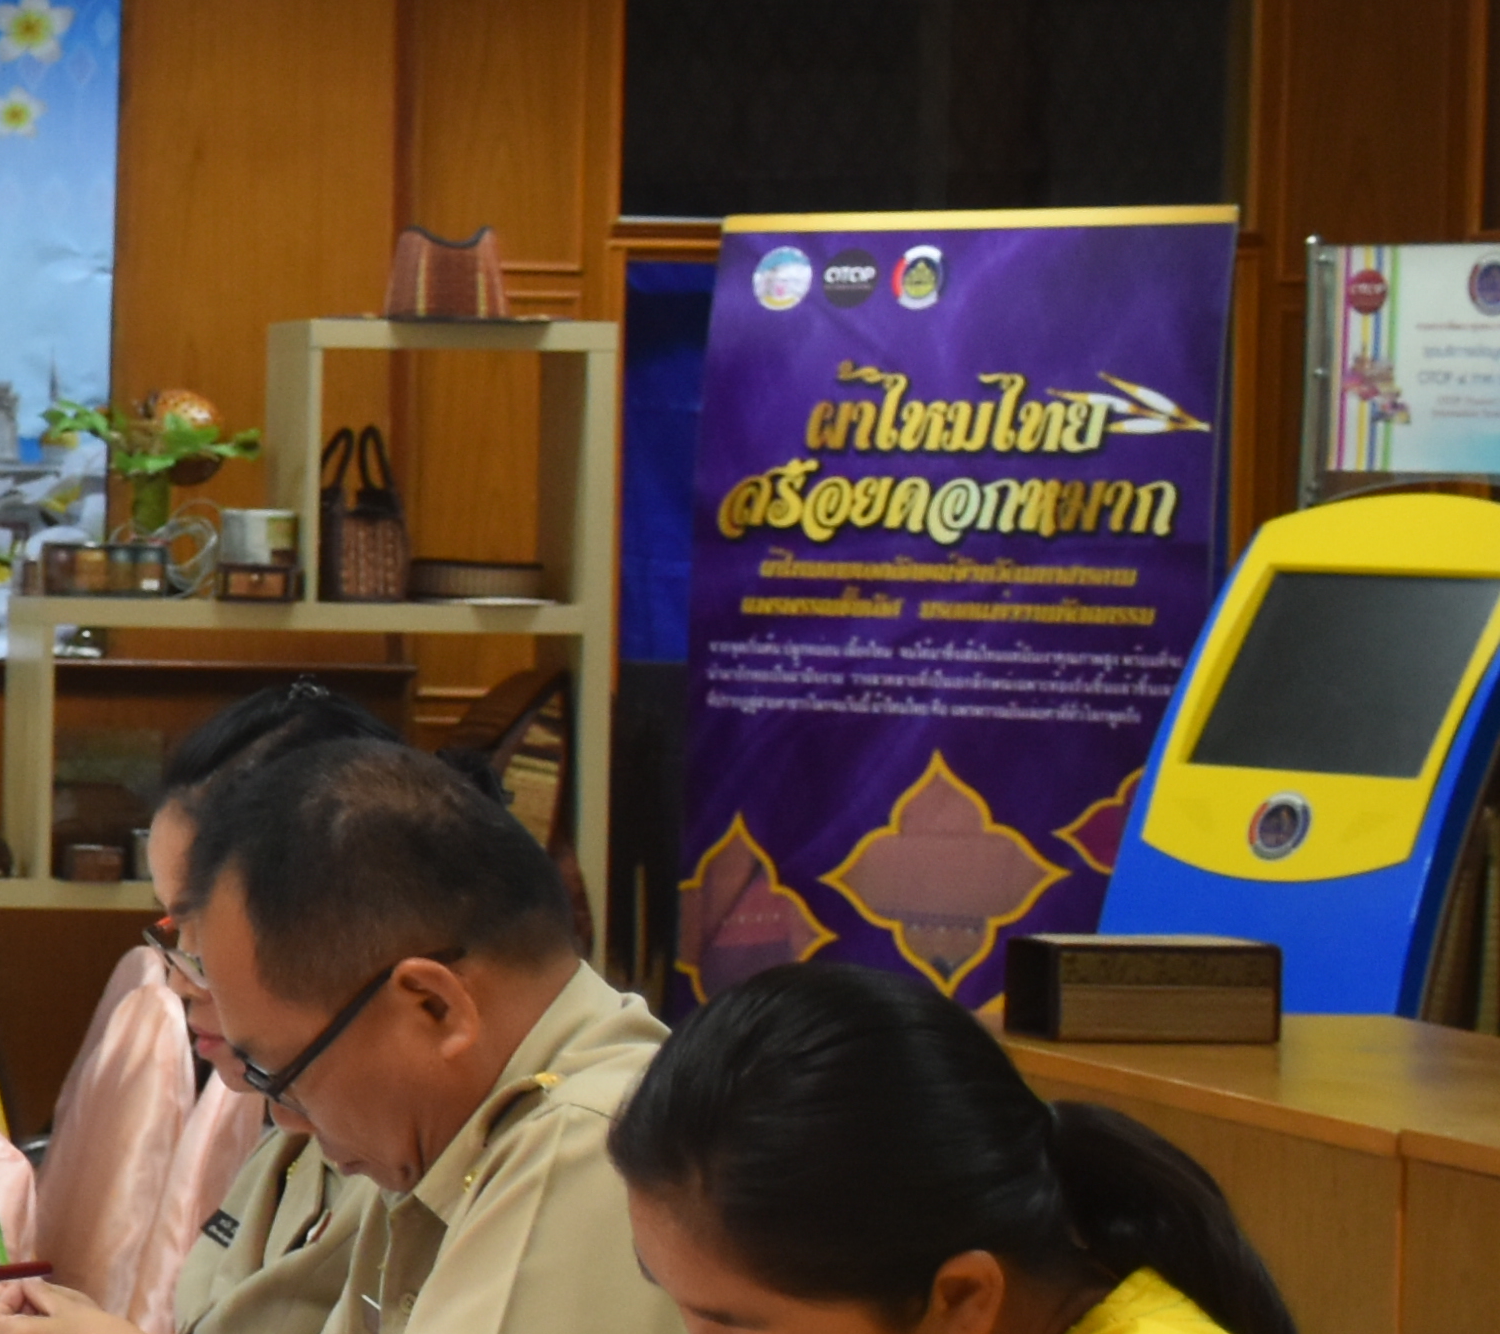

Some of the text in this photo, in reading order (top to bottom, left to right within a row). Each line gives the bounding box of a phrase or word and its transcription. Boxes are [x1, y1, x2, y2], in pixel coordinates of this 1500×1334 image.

[804, 359, 1114, 453] ผ้าไหมไทย
[717, 457, 1178, 545] สร้อยดอกหมาก
